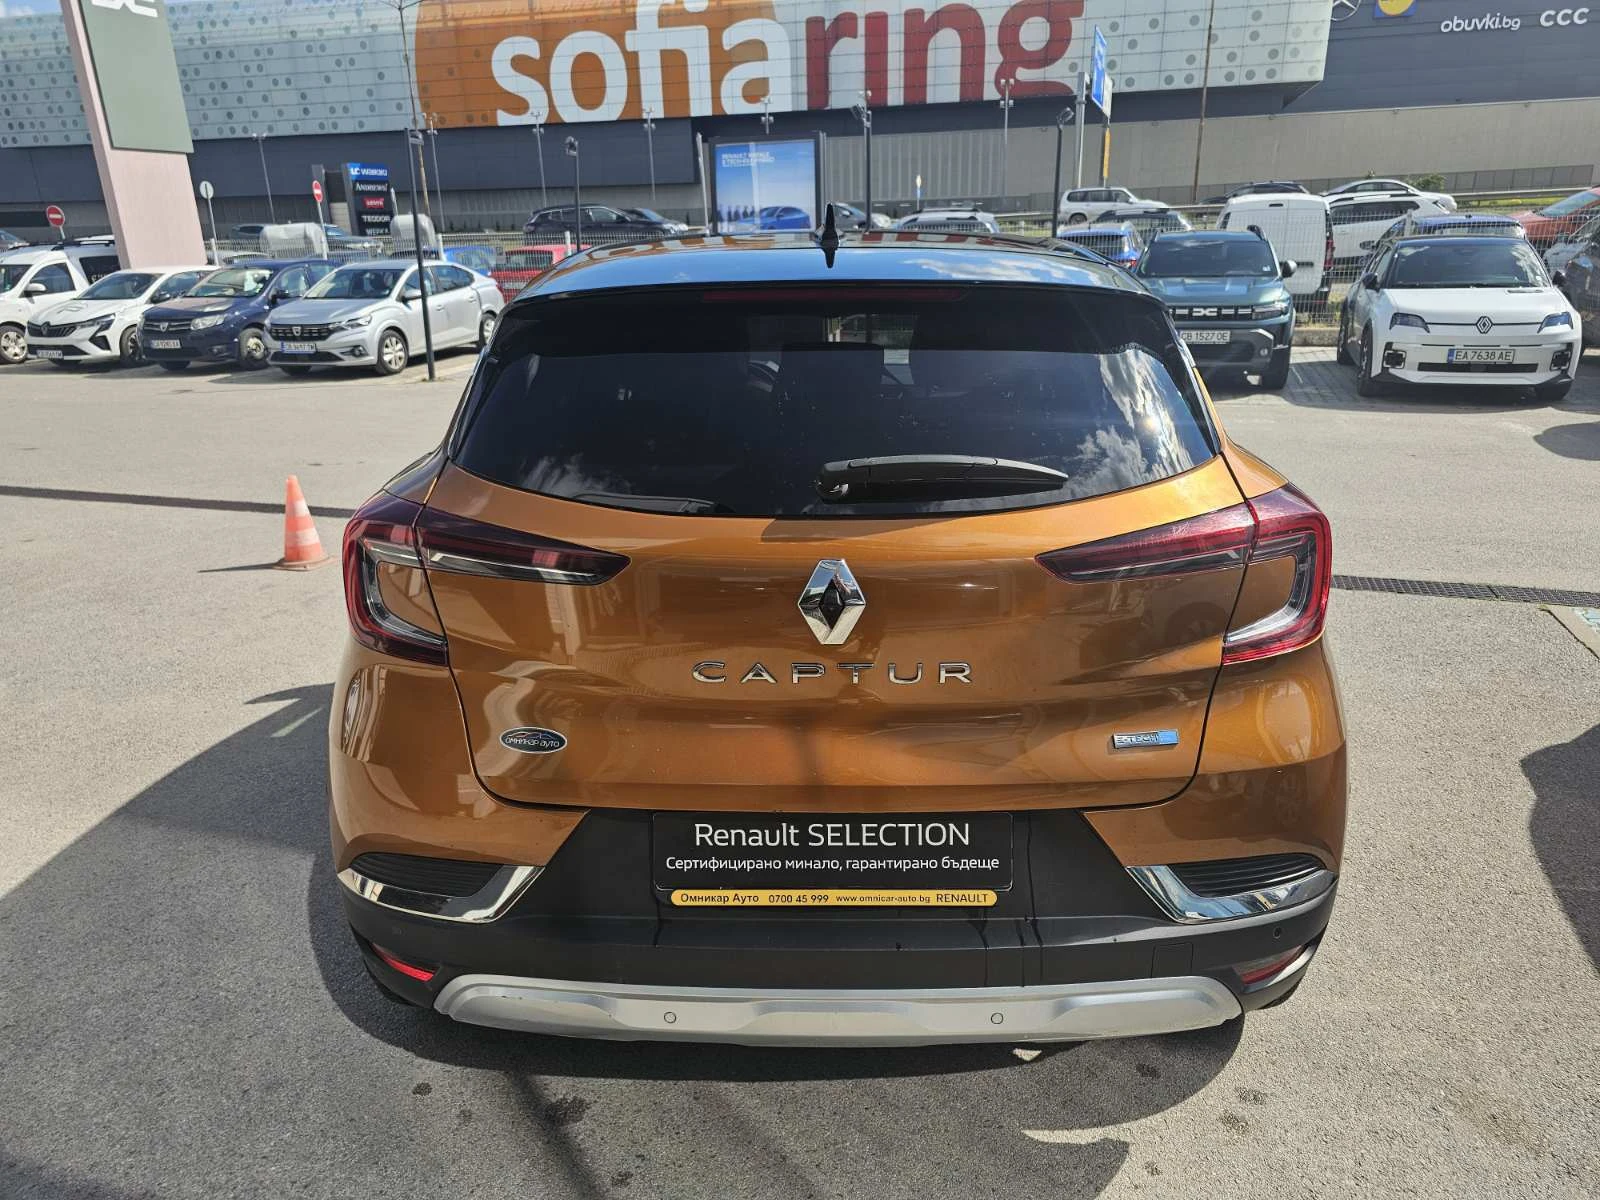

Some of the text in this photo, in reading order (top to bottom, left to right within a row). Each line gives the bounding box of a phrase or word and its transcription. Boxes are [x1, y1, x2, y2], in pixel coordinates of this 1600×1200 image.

[1440, 13, 1521, 33] obuvki.bg
[1455, 351, 1512, 360] EA 7638 AE
[691, 661, 972, 685] CAPTUR
[694, 823, 970, 847] Renault SELECTION
[666, 855, 1000, 872] Сертифицирано минало, гарантирано бъдеще
[680, 893, 989, 904] Омникар Ауто 0700 45 999 www.omnicar-auto.bg RENAULT
